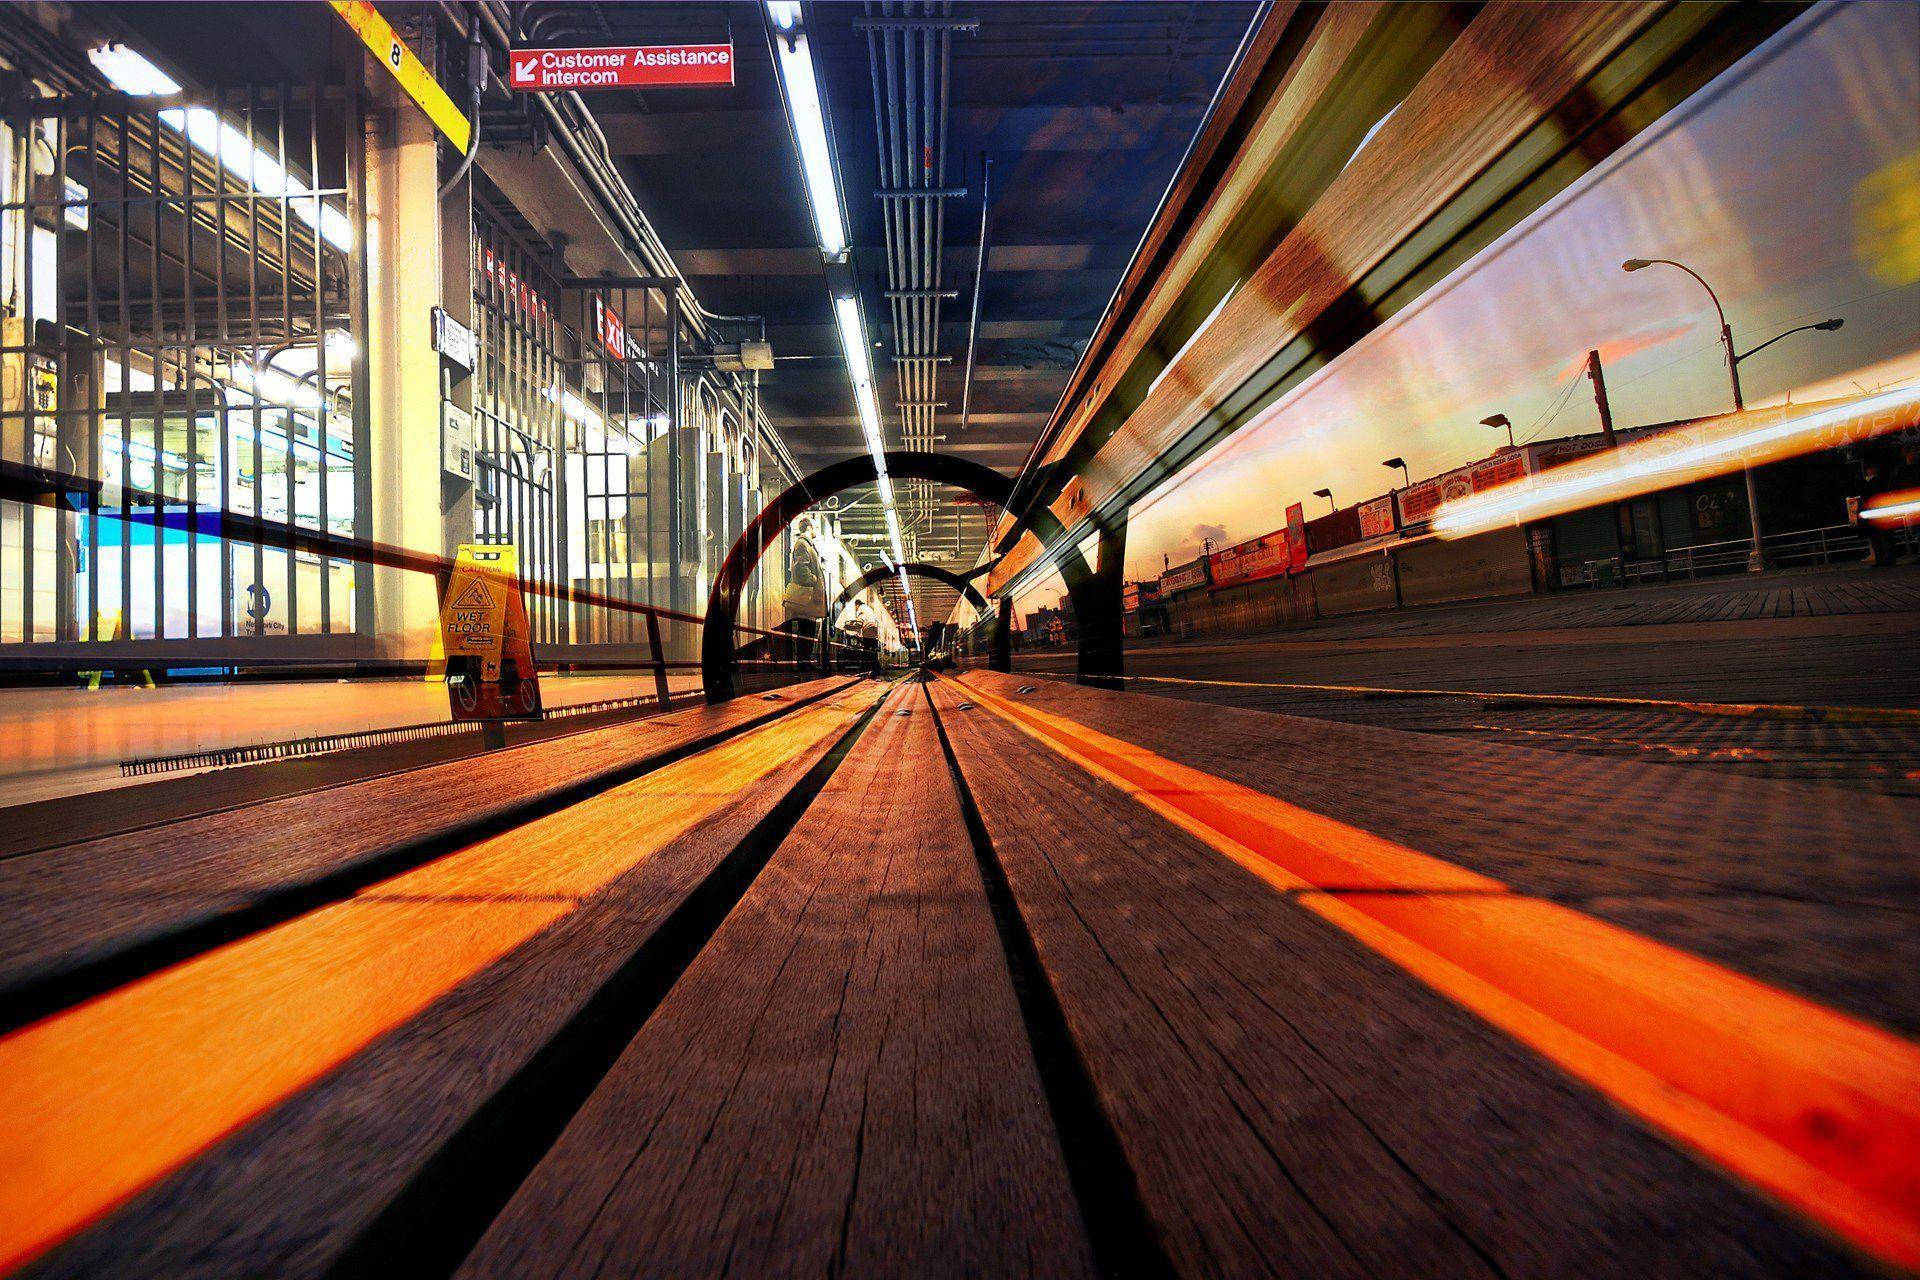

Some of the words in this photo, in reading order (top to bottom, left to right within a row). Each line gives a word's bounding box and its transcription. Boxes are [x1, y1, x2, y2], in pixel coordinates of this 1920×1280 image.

[391, 43, 400, 66] 8
[541, 52, 627, 69] Customer
[633, 49, 730, 67] Assistance
[541, 69, 619, 86] Intercom
[1558, 443, 1578, 454] HOT
[1580, 439, 1608, 451] DOGS
[456, 611, 486, 622] WET
[447, 623, 491, 633] FLOOR
